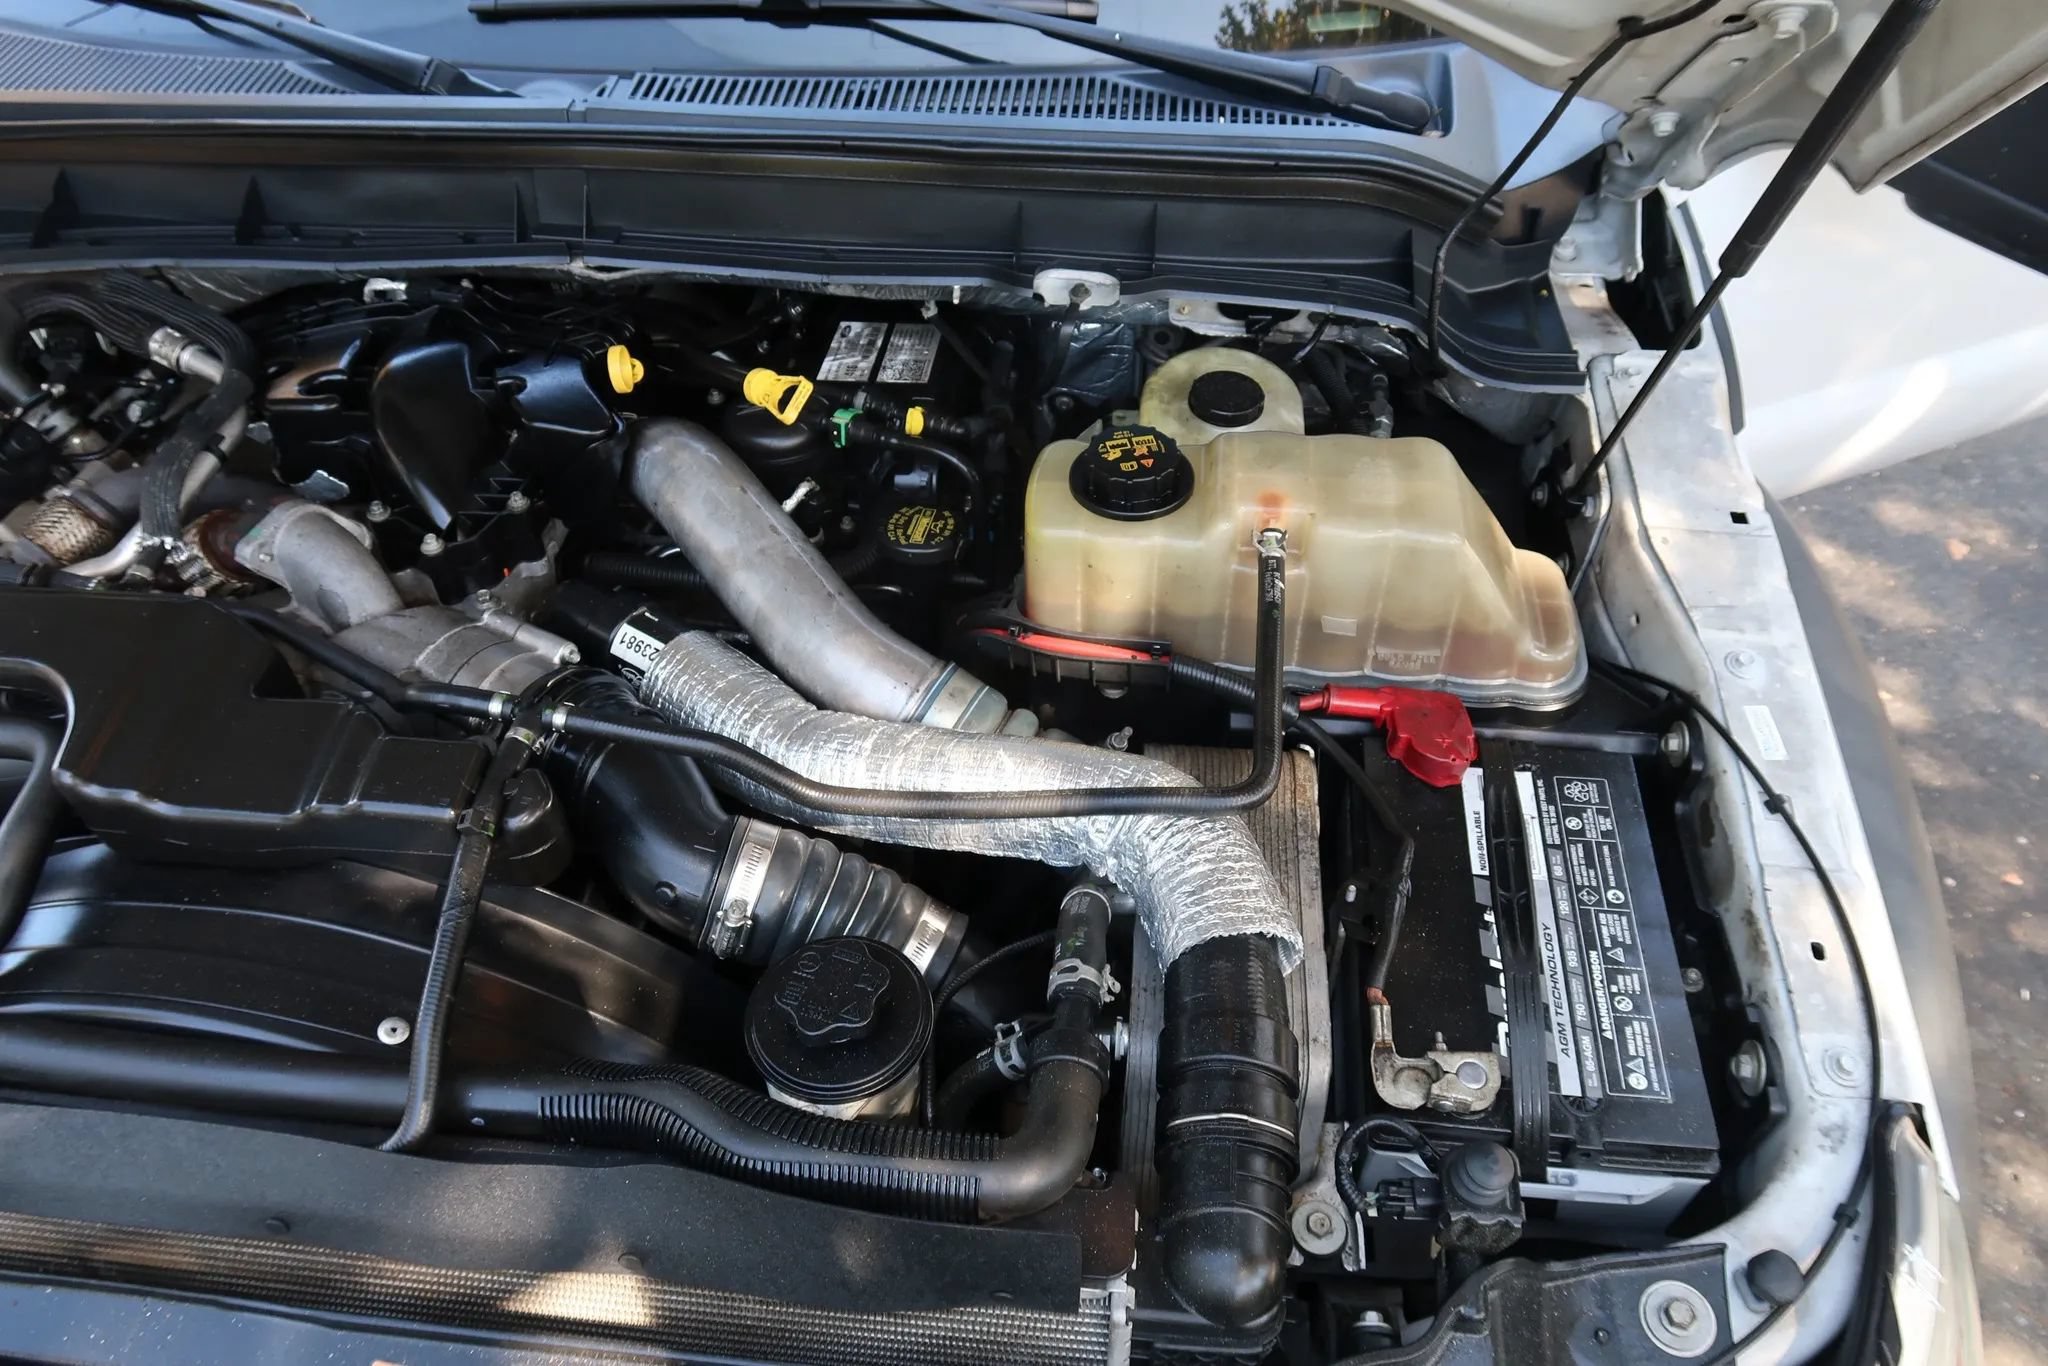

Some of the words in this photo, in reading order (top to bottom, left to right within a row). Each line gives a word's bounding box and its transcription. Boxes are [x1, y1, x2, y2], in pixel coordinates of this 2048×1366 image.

[1475, 809, 1488, 872] NON-SPILLABLE
[1559, 899, 1570, 914] 120
[1543, 922, 1563, 1017] TECHNOLOGY
[1566, 950, 1578, 967] 935
[1588, 950, 1611, 1030] DANGER/POISON
[1575, 1003, 1587, 1021] 750
[1557, 1022, 1570, 1058] AGM
[1582, 1035, 1596, 1071] 65-AGM
